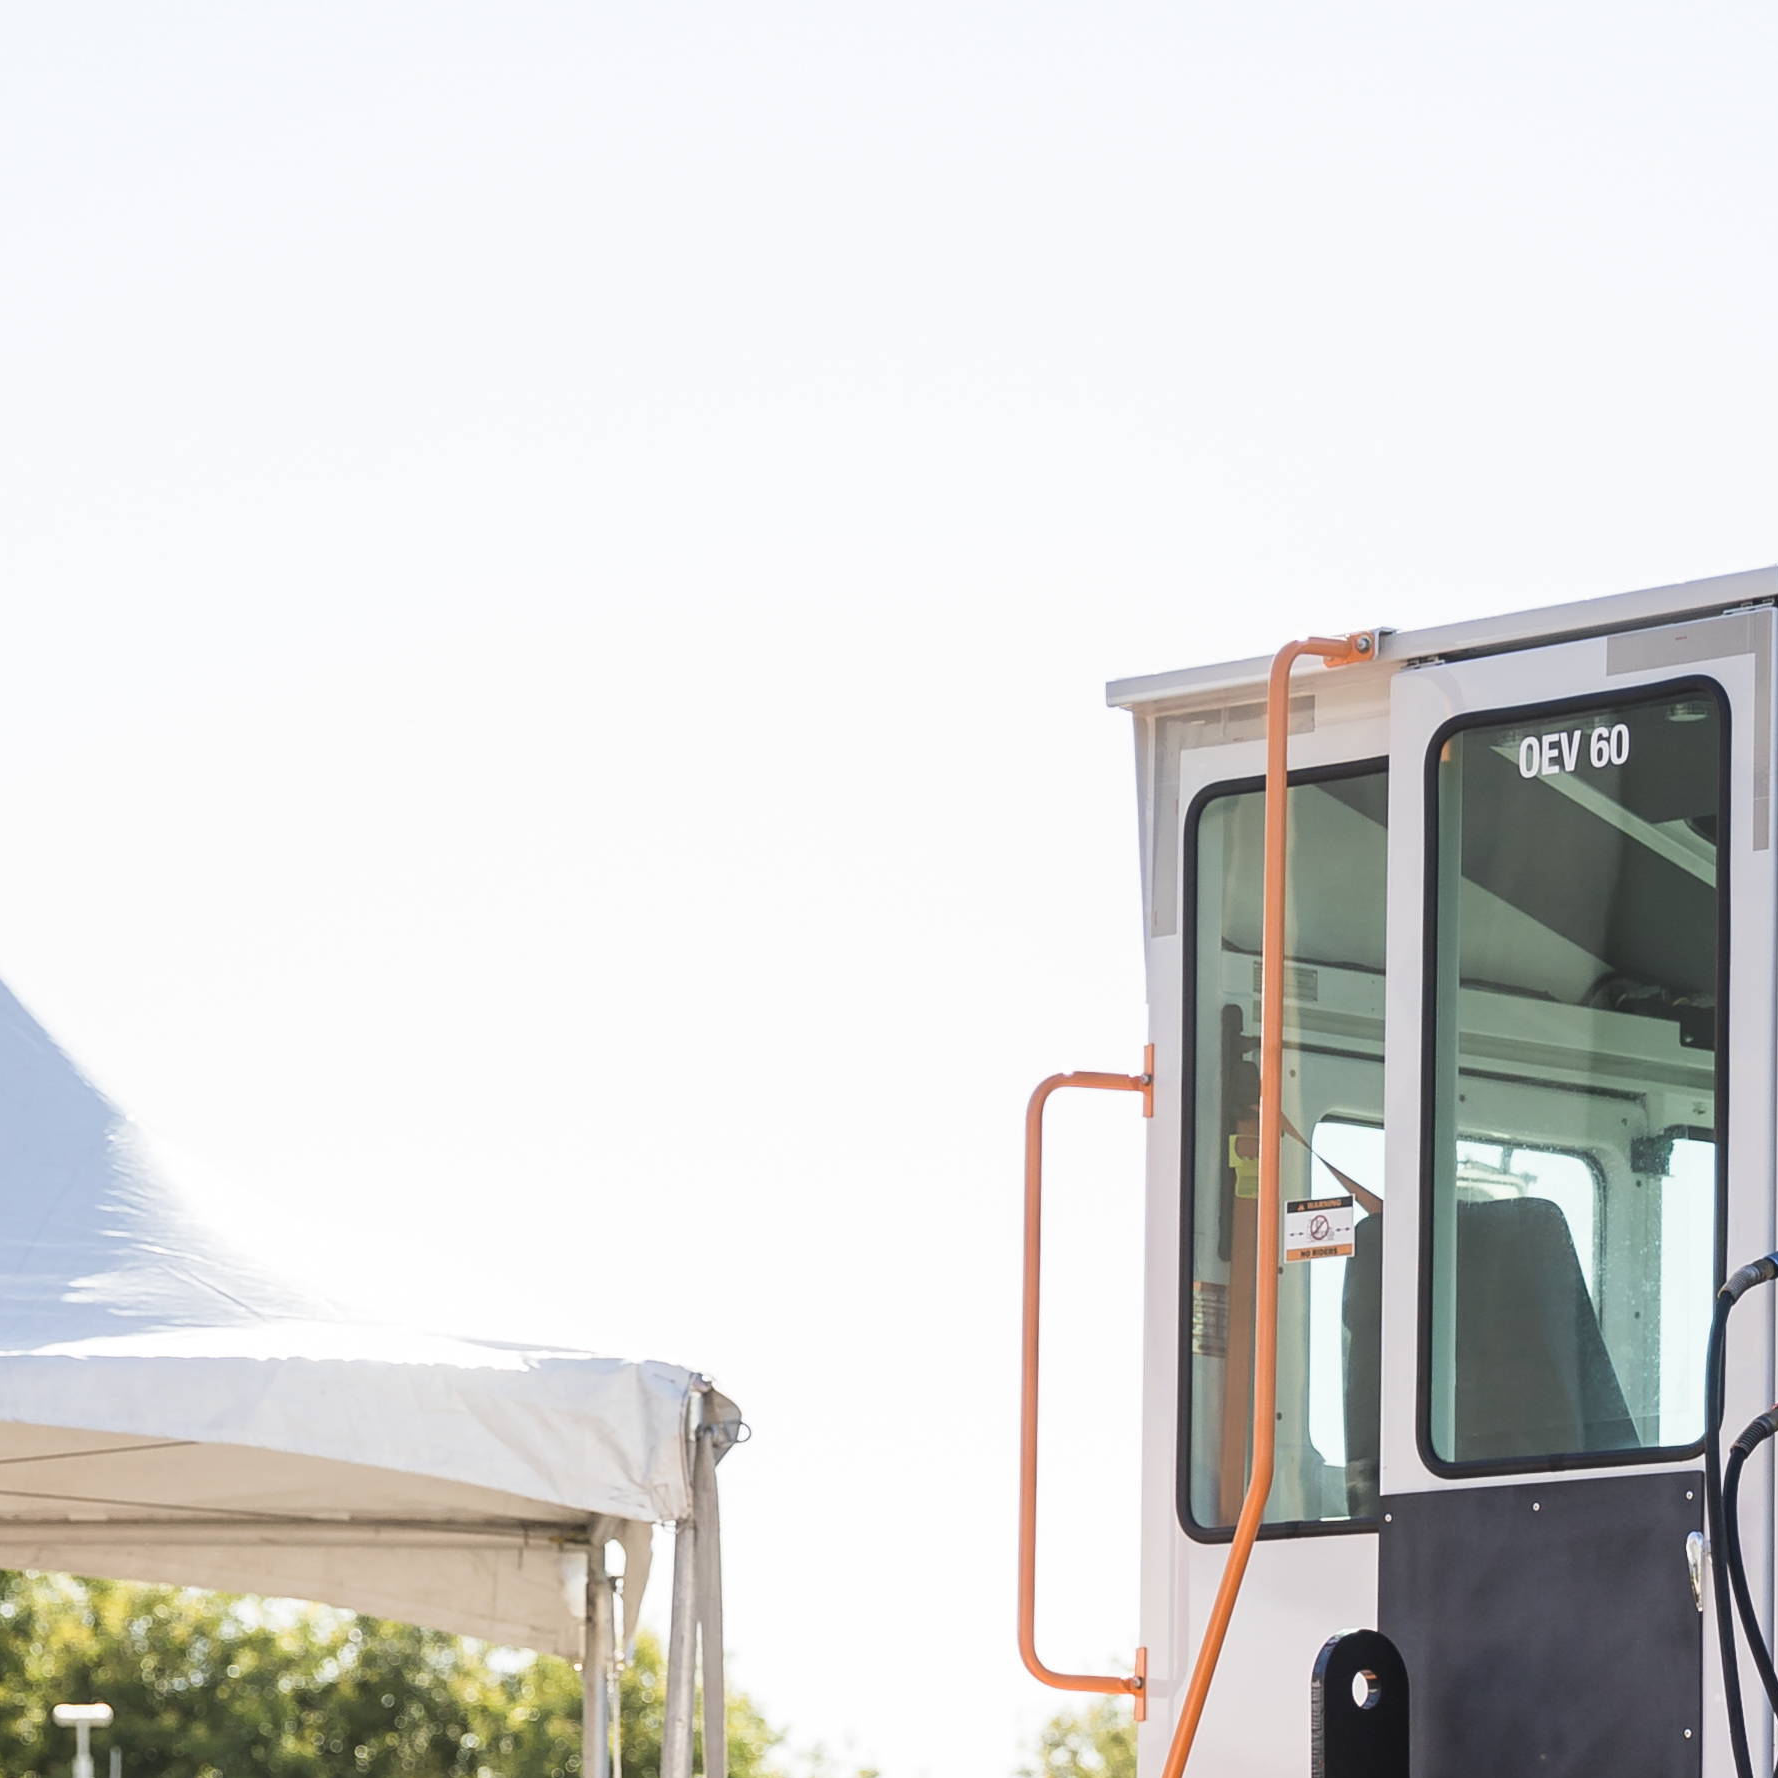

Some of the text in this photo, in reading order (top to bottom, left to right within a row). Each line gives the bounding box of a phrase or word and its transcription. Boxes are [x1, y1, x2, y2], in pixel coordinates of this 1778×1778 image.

[1519, 723, 1630, 778] OEV 60
[1307, 1199, 1342, 1209] WARNING
